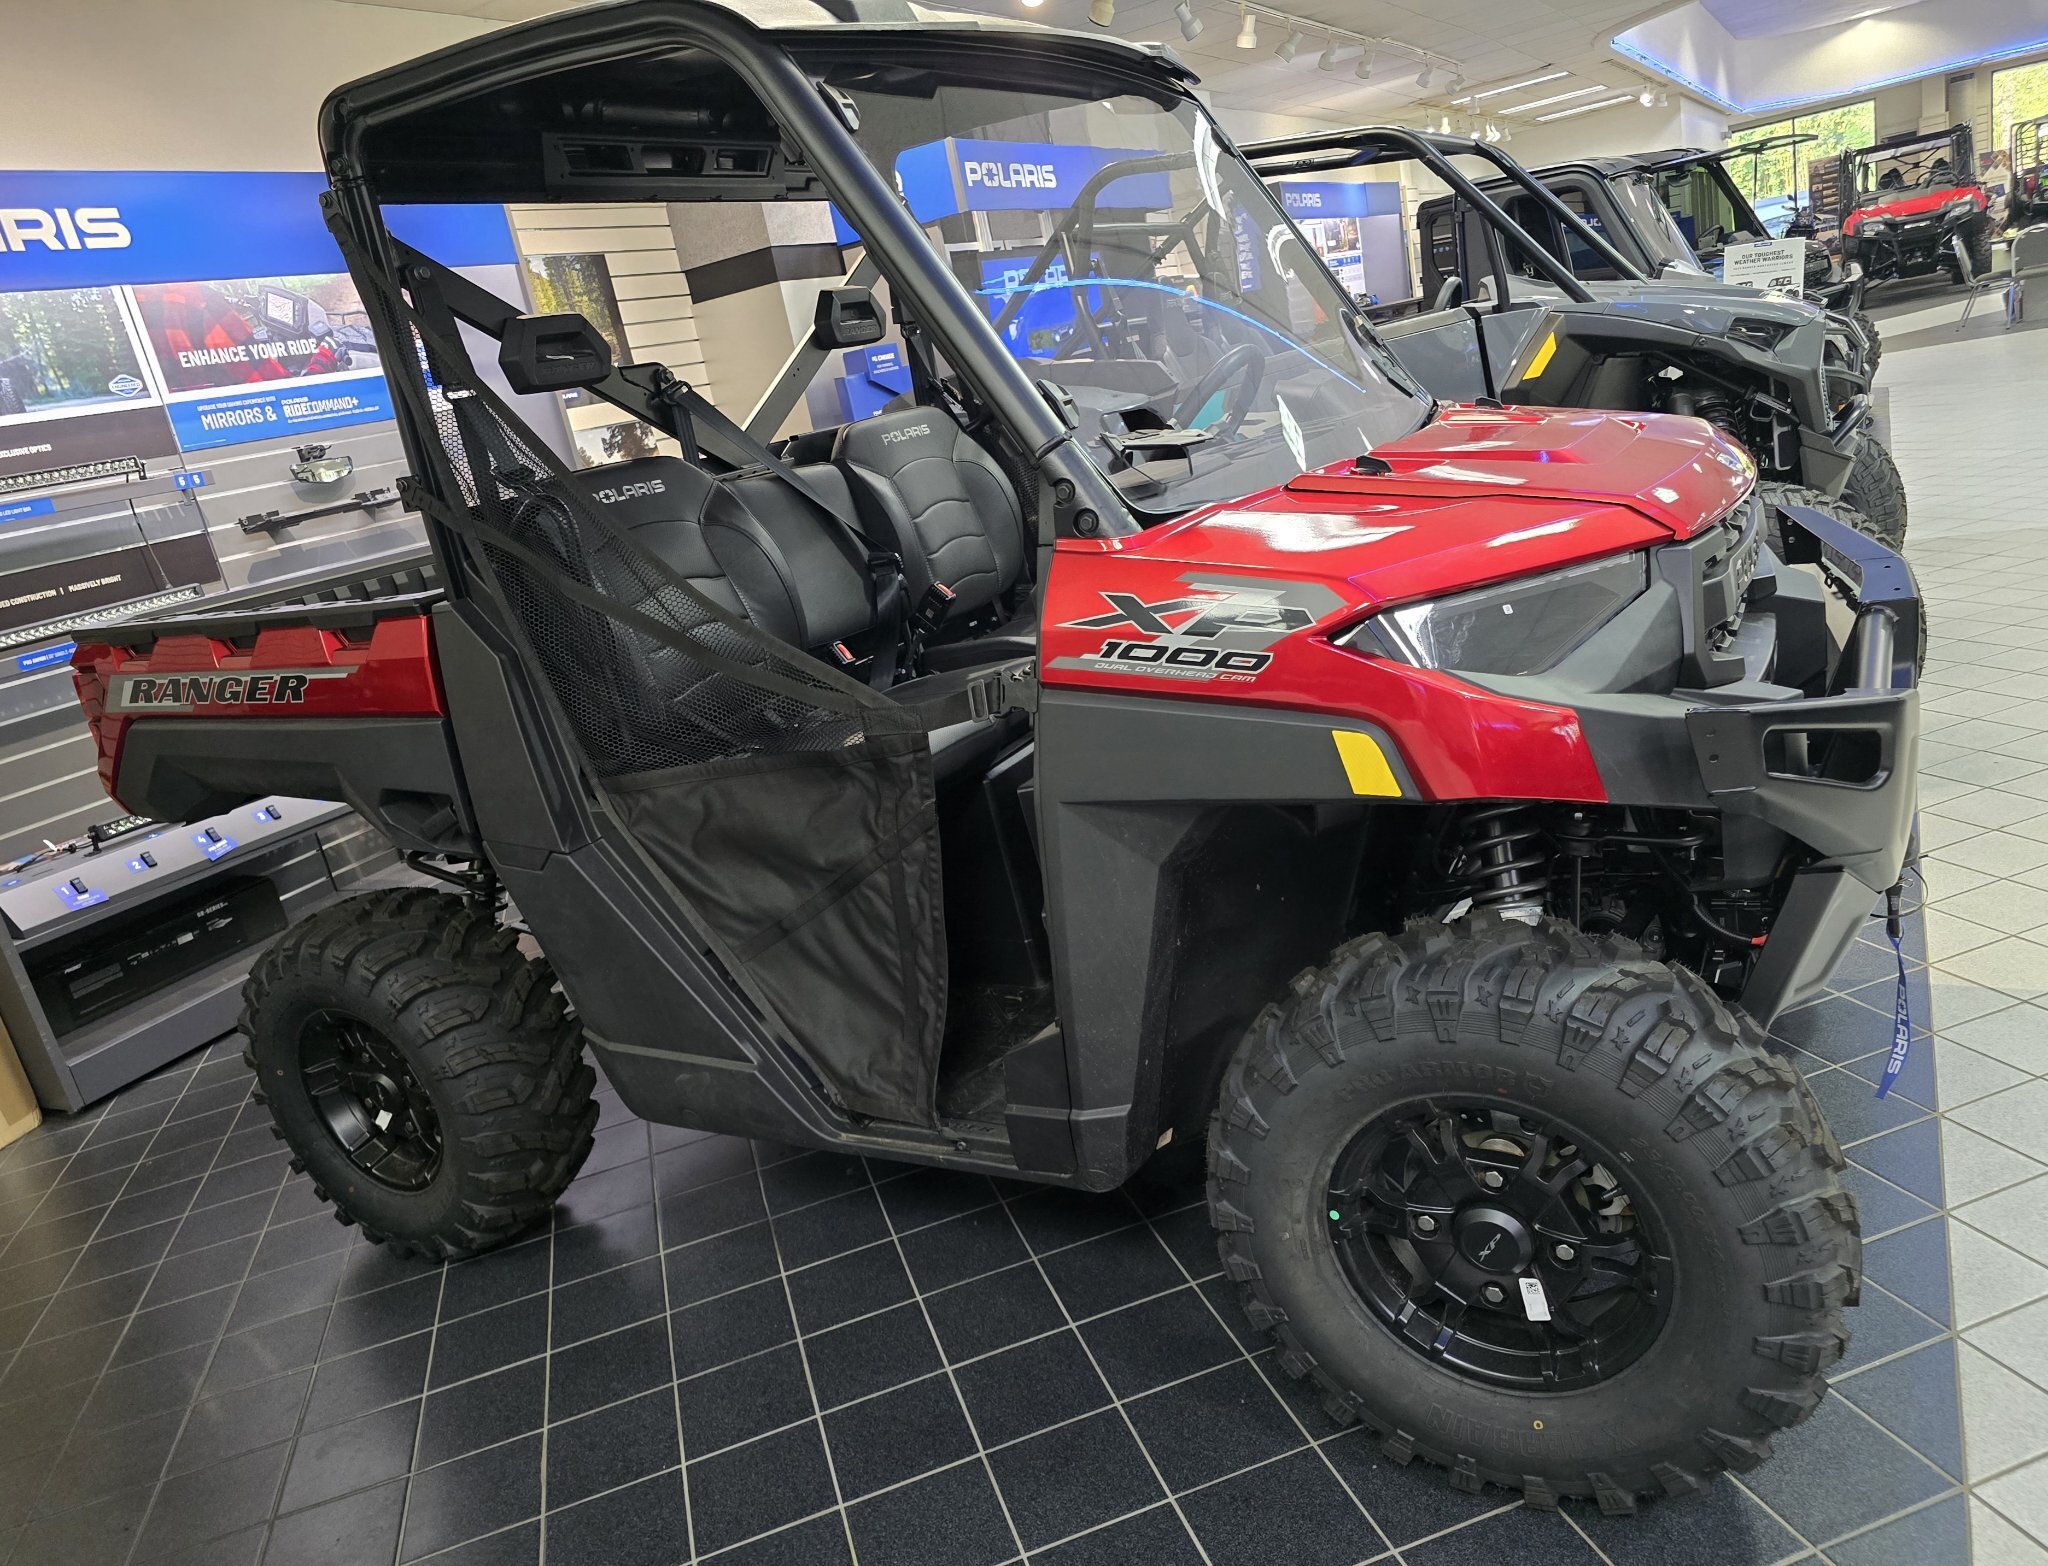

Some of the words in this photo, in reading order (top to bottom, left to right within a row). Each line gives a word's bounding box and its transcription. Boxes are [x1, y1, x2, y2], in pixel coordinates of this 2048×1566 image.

[964, 161, 1057, 189] POLARIS
[1285, 193, 1322, 208] POLARIS
[1734, 257, 1761, 265] WEATHER
[1762, 253, 1793, 263] WARRIORS
[1754, 249, 1785, 258] TOUGHEST
[178, 346, 250, 368] ENHANCE
[251, 341, 288, 360] YOUR
[289, 338, 318, 355] RIDE
[201, 407, 263, 431] MIRRORS
[266, 405, 278, 422] &
[881, 423, 931, 446] POLARIS
[29, 443, 52, 454] OPTICS
[10, 589, 57, 606] CONSTRUCTION
[68, 579, 101, 593] MASSIVELY
[101, 574, 122, 585] BRIGHT
[1053, 591, 1317, 640] XP
[1096, 638, 1273, 674] 1000
[1094, 662, 1133, 672] DUAL
[1135, 665, 1217, 680] OVERHEAD
[1219, 673, 1257, 683] CAM
[128, 674, 309, 705] RANGER
[132, 861, 142, 871] 2
[1886, 983, 1909, 1075] POLARIS
